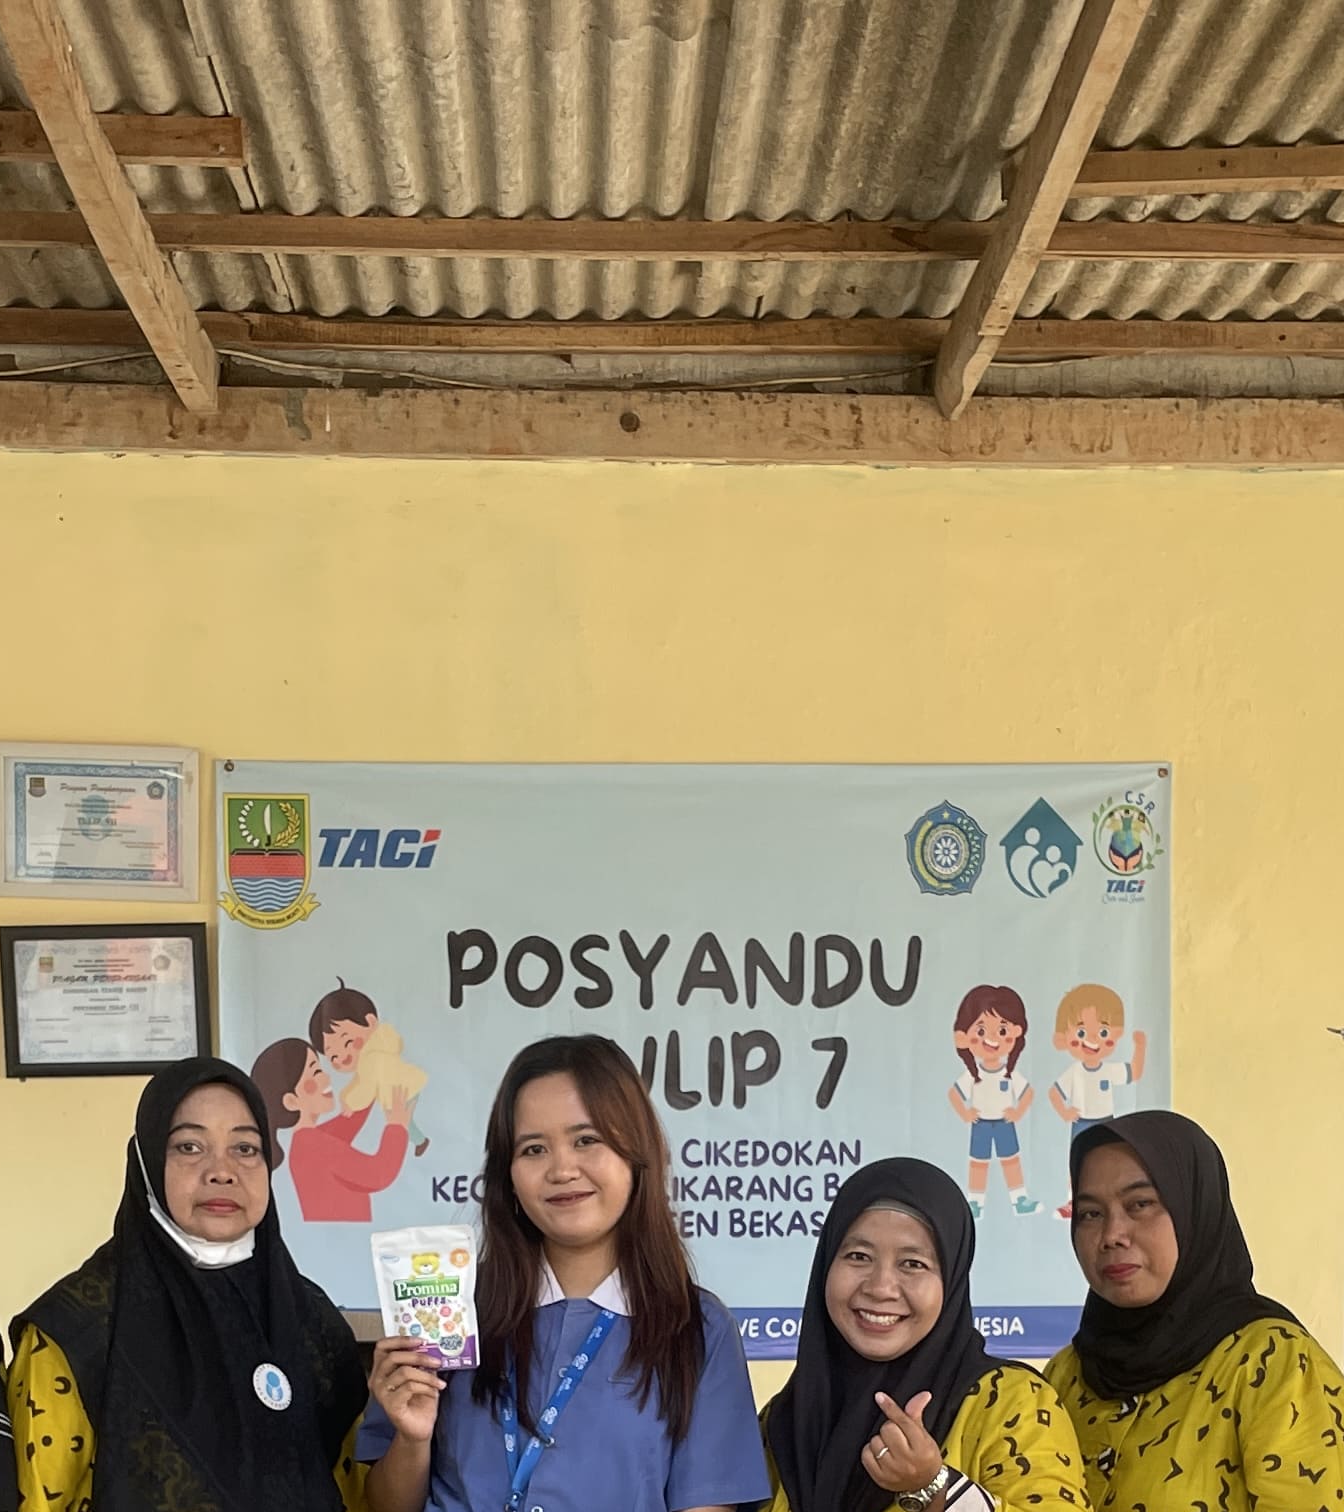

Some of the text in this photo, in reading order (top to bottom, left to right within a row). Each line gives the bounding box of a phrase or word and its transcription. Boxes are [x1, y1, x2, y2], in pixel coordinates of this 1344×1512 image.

[1124, 790, 1155, 816] CSR
[447, 928, 922, 1010] POSYANDU
[811, 1036, 848, 1110] 7
[680, 1138, 862, 1169] CIKEDOKAN
[670, 1174, 814, 1203] IKARANG
[673, 1208, 719, 1238] EN
[397, 1279, 458, 1298] Promina
